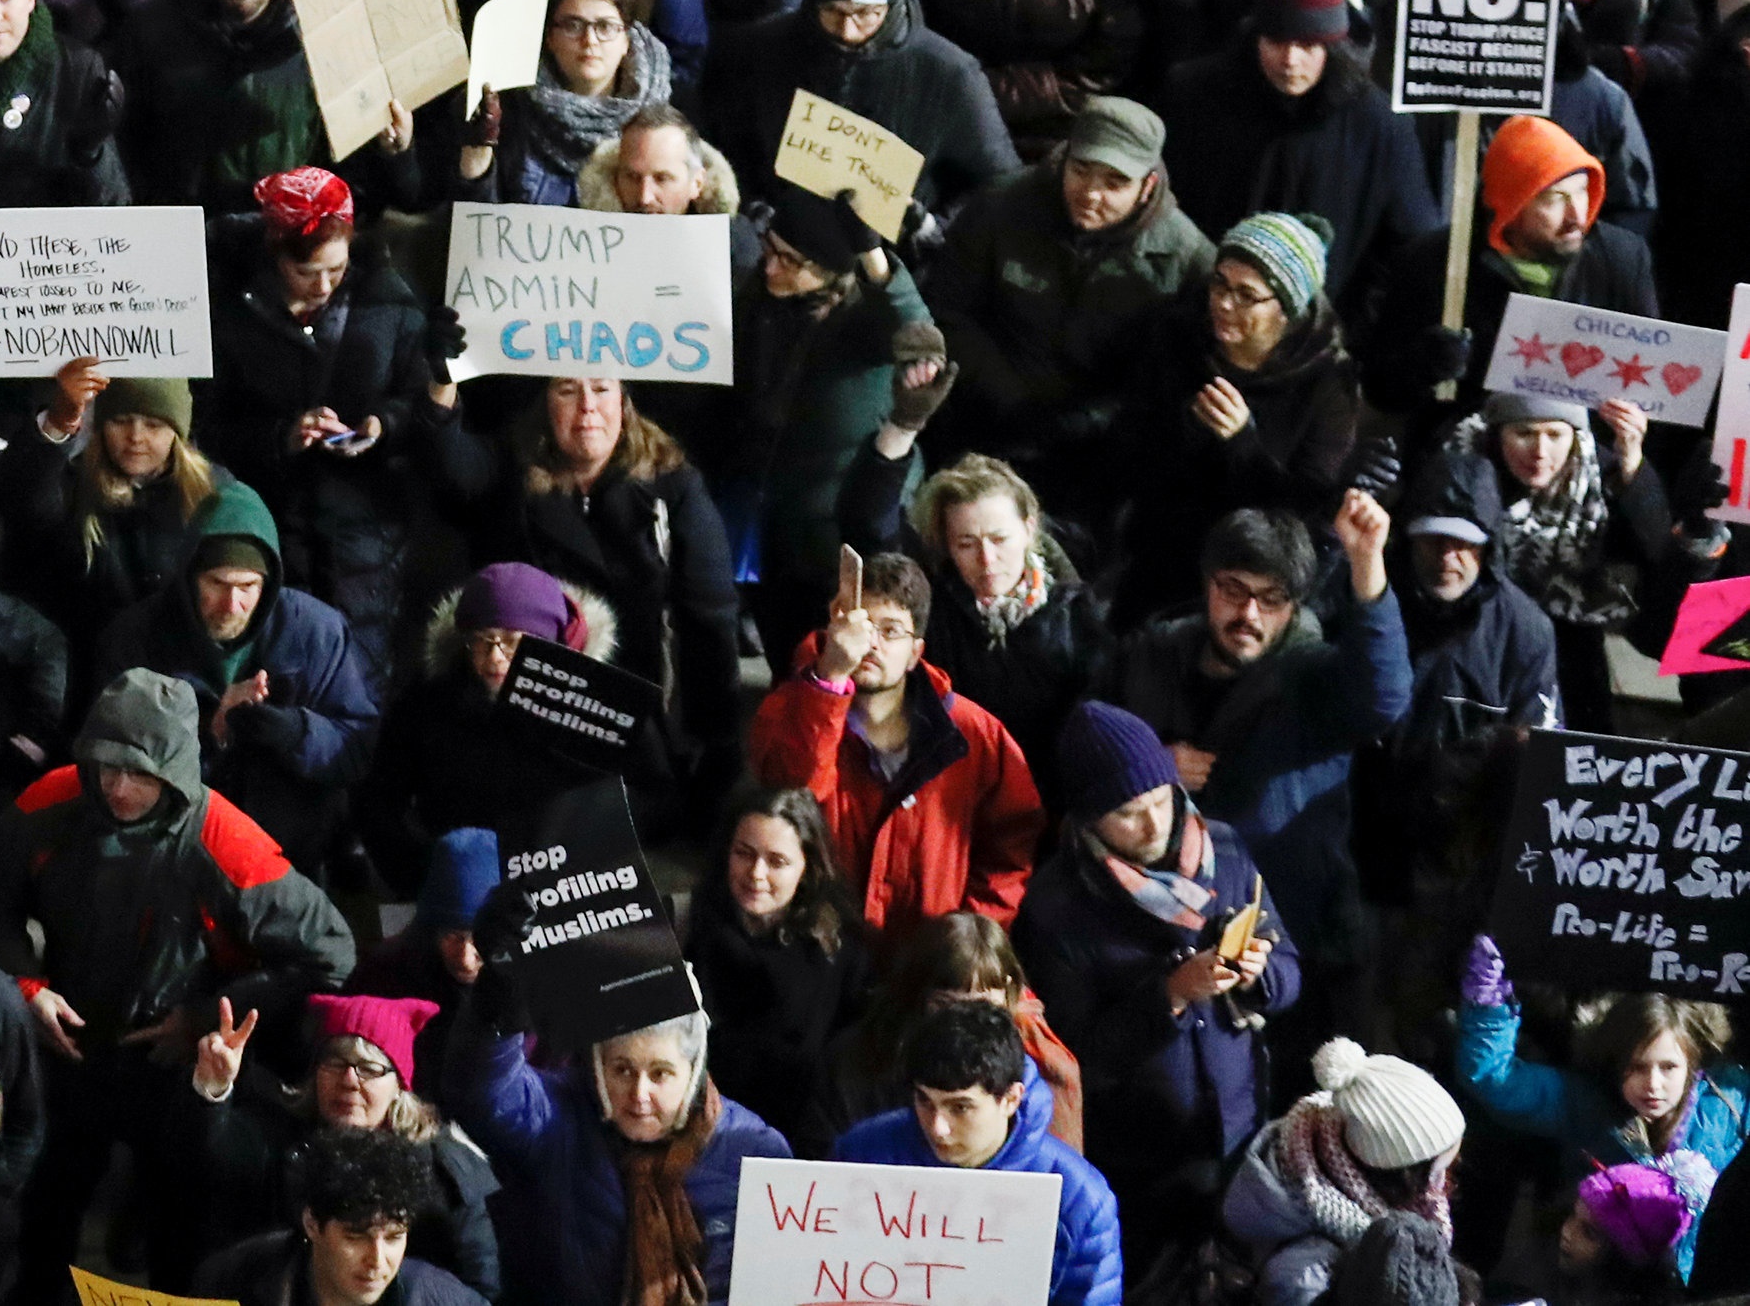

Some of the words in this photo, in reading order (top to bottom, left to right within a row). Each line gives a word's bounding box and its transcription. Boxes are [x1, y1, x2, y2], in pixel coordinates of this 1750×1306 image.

[1409, 18, 1447, 36] STOP
[1409, 37, 1478, 57] FASCIST
[1480, 42, 1545, 61] REGIME
[1408, 55, 1468, 75] BEFORE
[1469, 61, 1485, 76] IT
[1485, 62, 1544, 79] STARTS
[801, 101, 818, 123] I
[785, 131, 833, 164] LIKE
[846, 155, 901, 204] TRUMP
[93, 236, 132, 256] THE
[465, 212, 626, 265] TRUMP
[15, 304, 36, 321] MY
[39, 302, 68, 318] LAMP
[72, 301, 106, 317] BESIDE
[39, 284, 78, 297] TOSSED
[86, 282, 104, 296] TO
[500, 318, 712, 374] CHAOS
[1574, 313, 1672, 346] CHICAGO
[521, 655, 589, 691] Stop
[508, 691, 627, 748] Muslims.
[513, 674, 636, 729] profiling
[1564, 745, 1710, 809] Every
[1542, 797, 1661, 848] Worth
[1672, 803, 1744, 854] the
[507, 843, 568, 881] Stop
[1550, 847, 1666, 896] Worth
[528, 864, 639, 912] rofiling
[520, 901, 654, 955] Muslims.
[1551, 902, 1678, 950] Pro-Life
[766, 1180, 840, 1234] WE
[874, 1190, 1005, 1244] WILL
[813, 1259, 967, 1301] NOT
